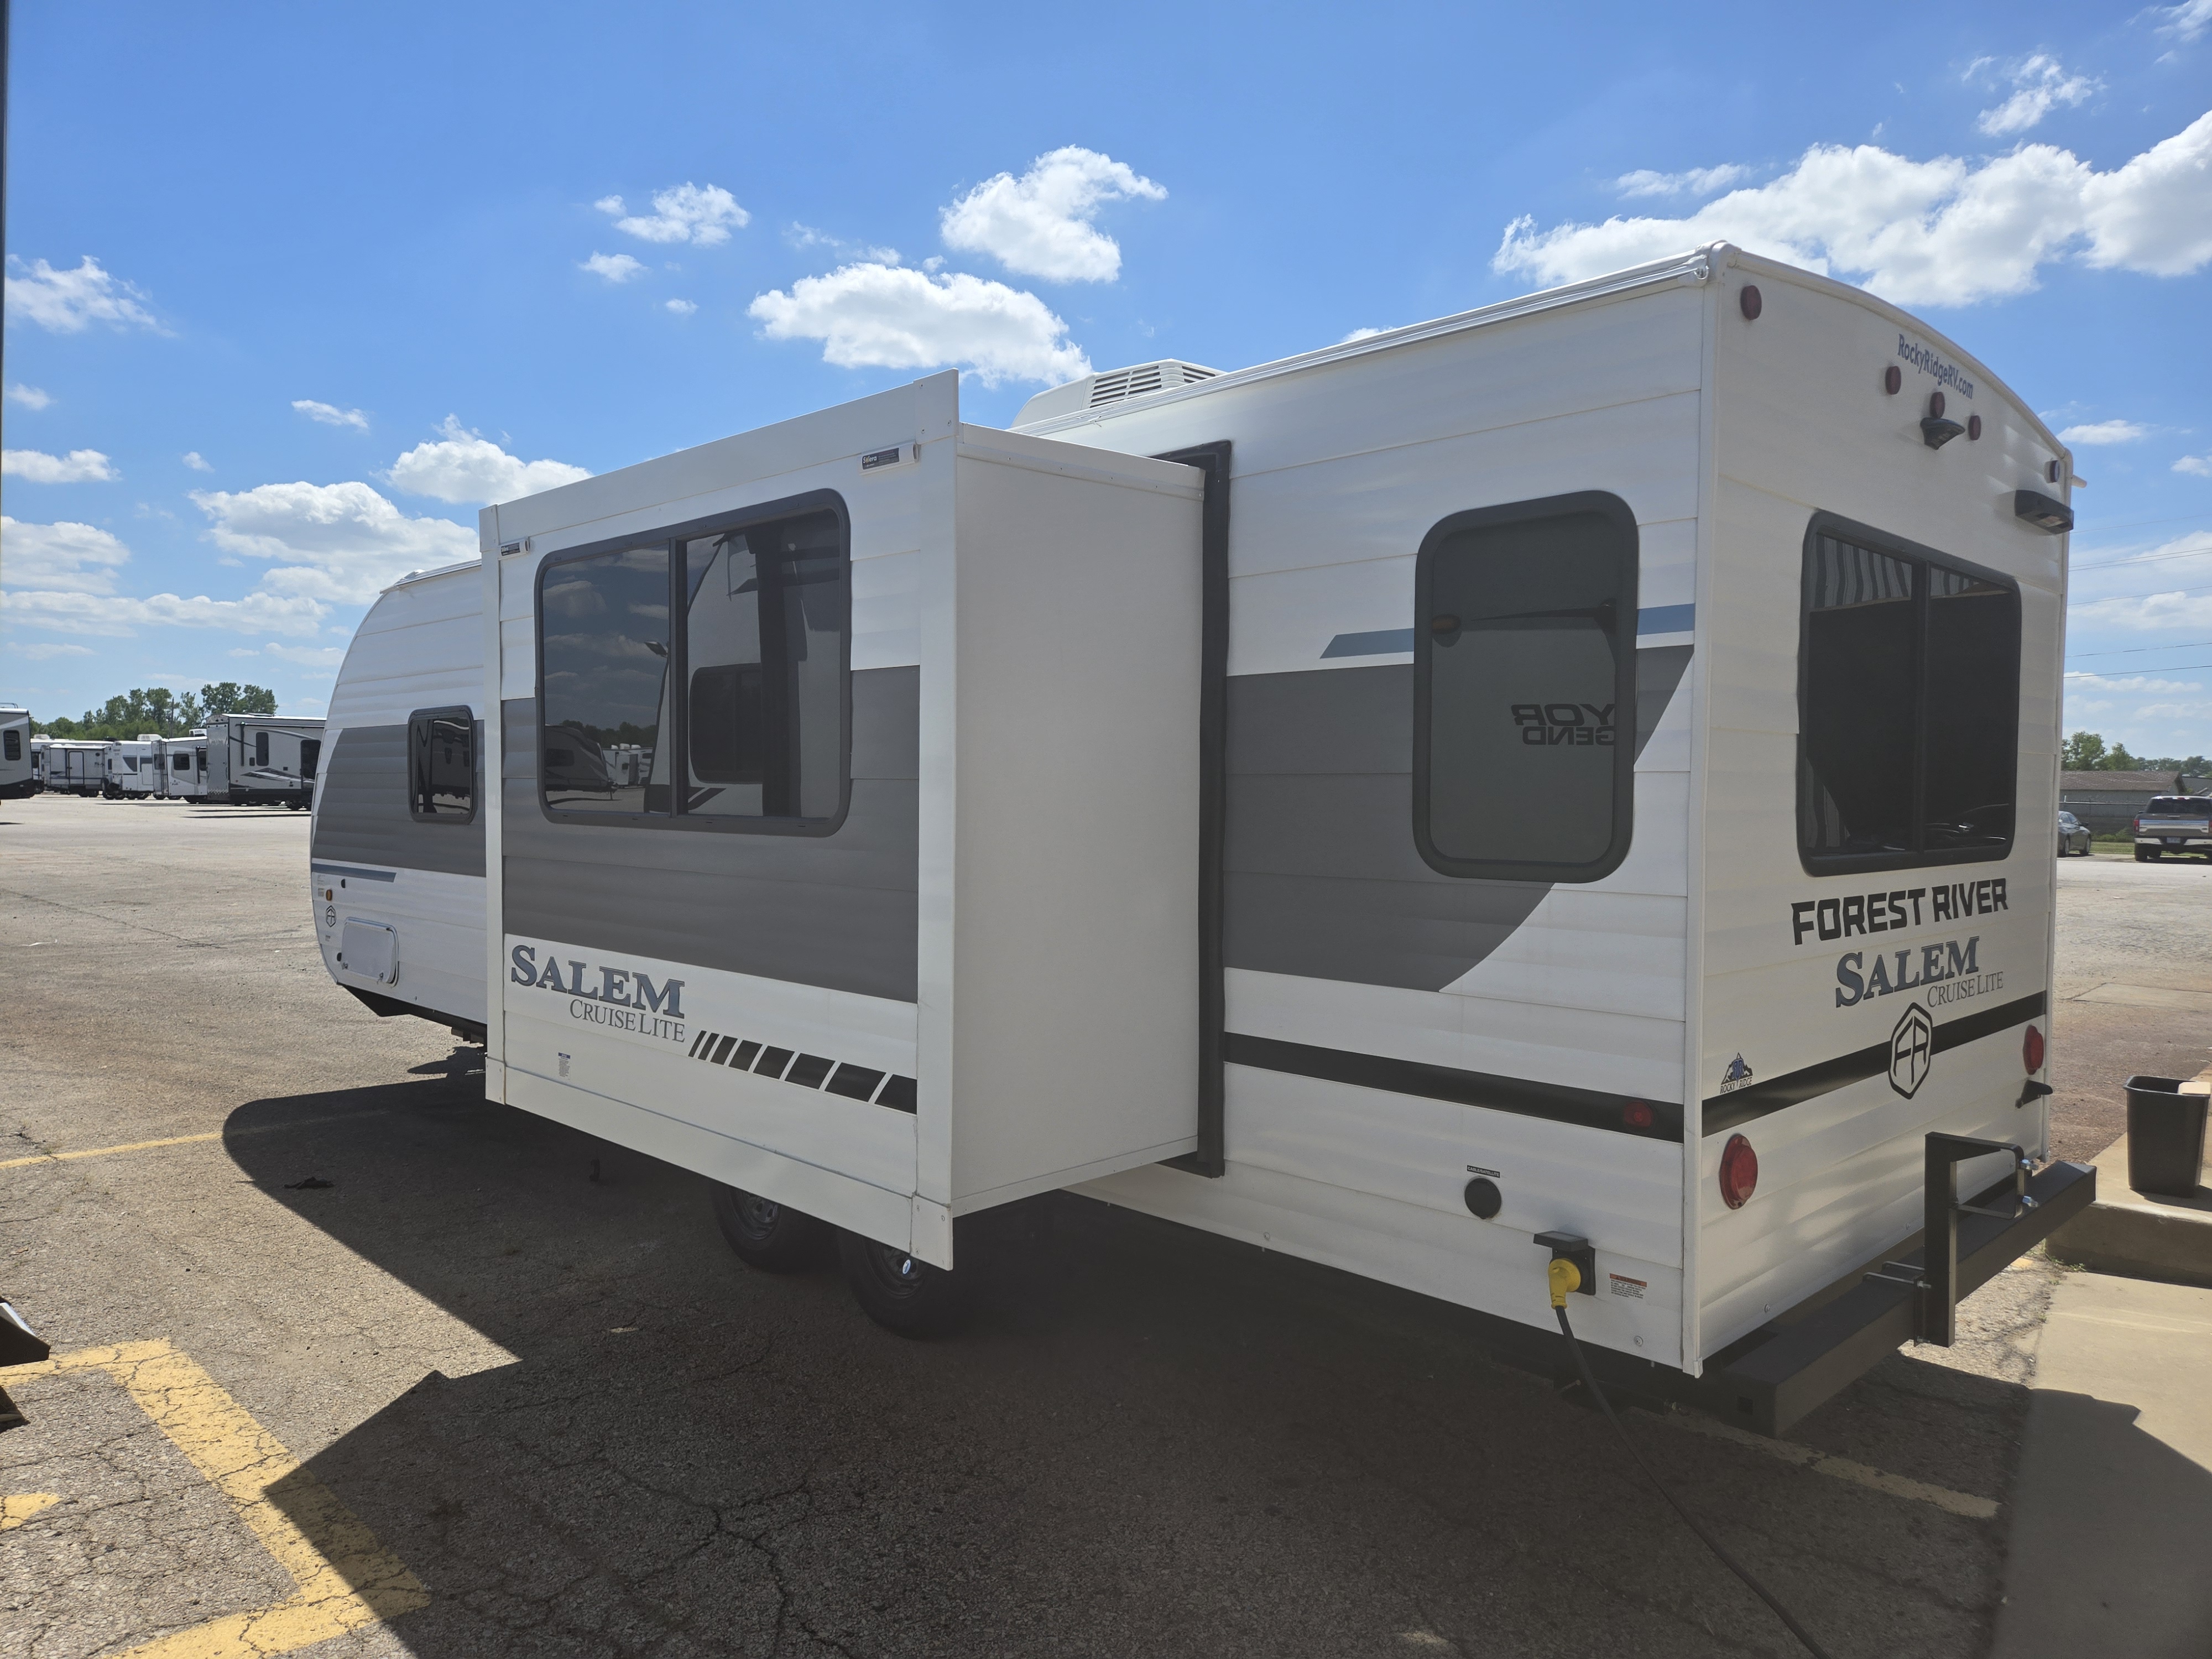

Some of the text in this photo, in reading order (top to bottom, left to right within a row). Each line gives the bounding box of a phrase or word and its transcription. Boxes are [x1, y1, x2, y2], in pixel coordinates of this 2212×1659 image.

[1897, 333, 1973, 399] RockyRidgeRV.com
[1791, 878, 2008, 945] FOREST RIVER
[511, 945, 685, 1019] SALEM
[1835, 936, 1980, 1008] SALEM
[1720, 1077, 1752, 1094] ROCKY RIDGE
